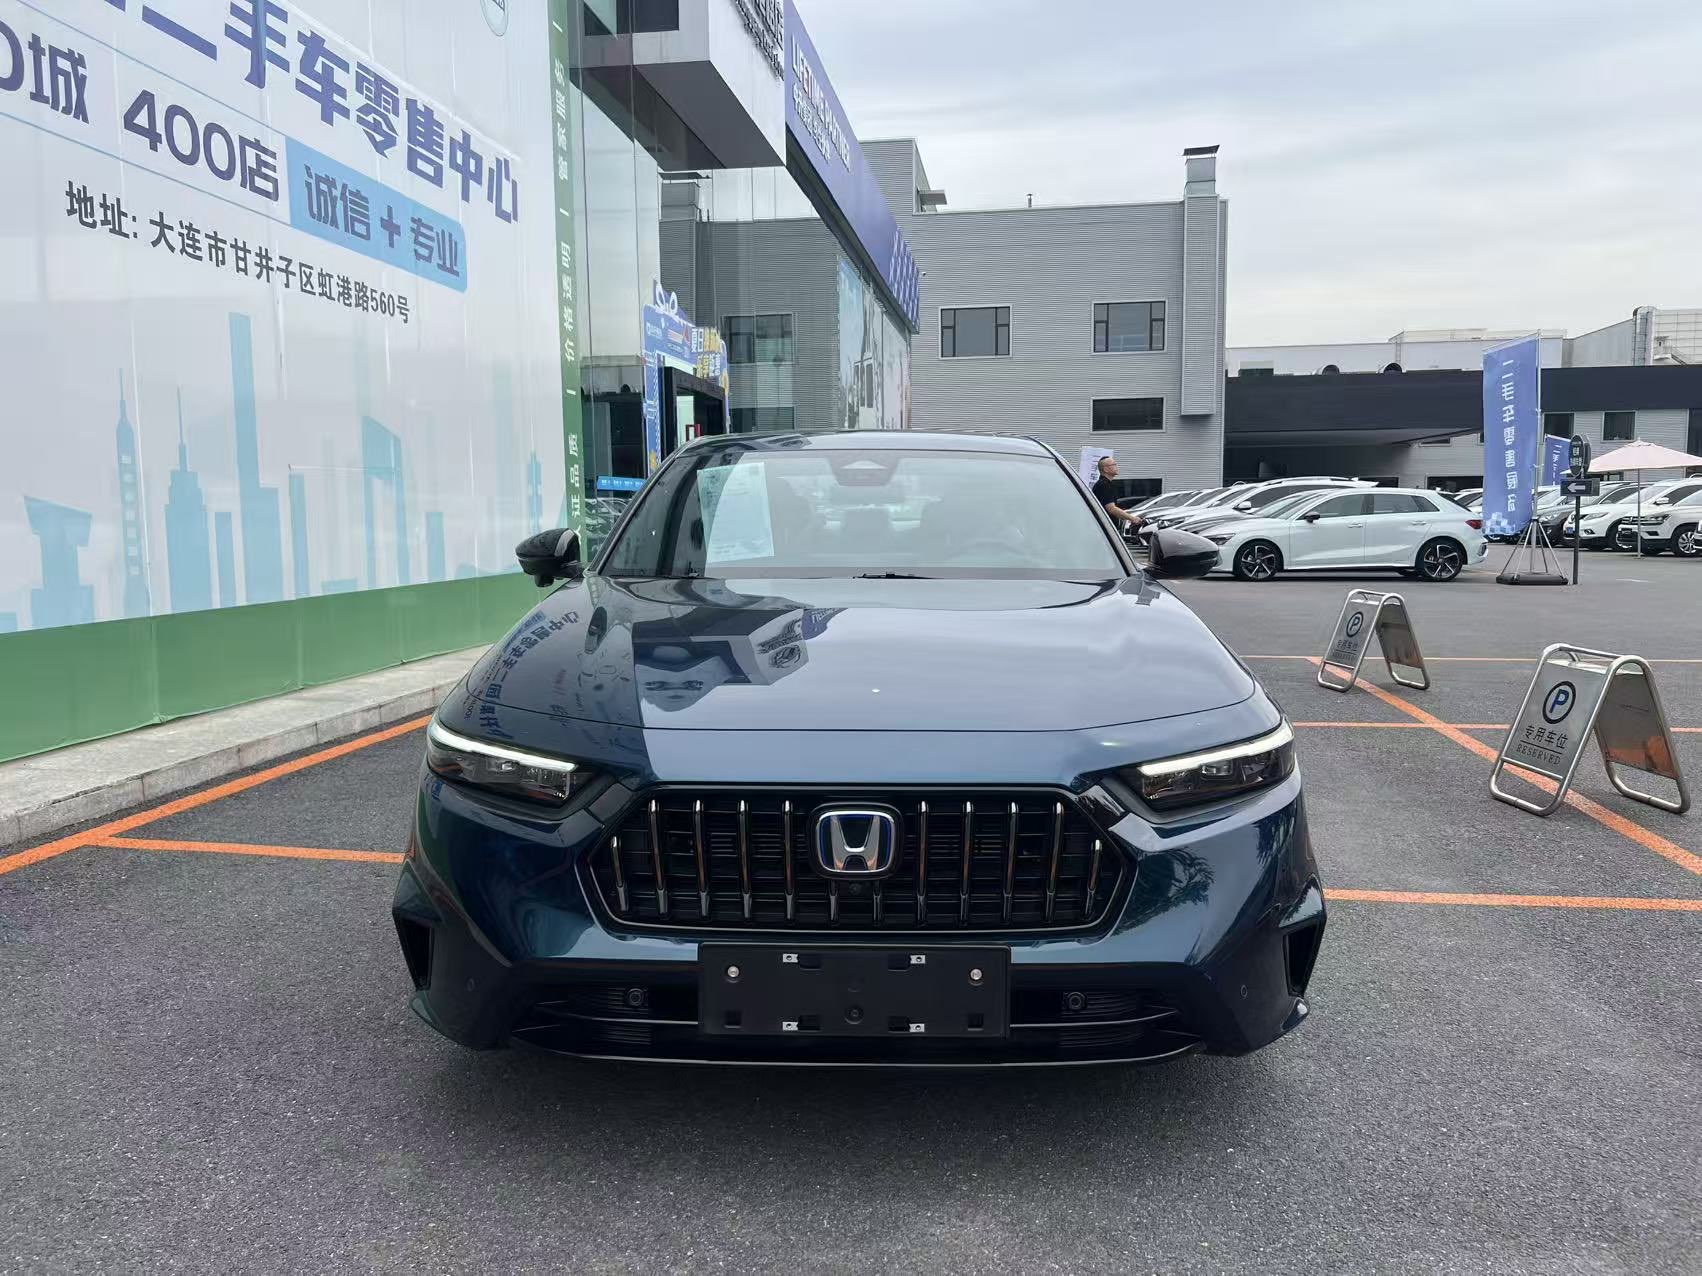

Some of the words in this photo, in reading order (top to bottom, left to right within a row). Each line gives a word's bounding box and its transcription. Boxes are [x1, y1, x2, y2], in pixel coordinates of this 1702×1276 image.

[107, 0, 518, 224] 二手车零售中心
[123, 89, 279, 202] 400店
[304, 164, 371, 241] 诚信
[410, 216, 460, 278] 专业
[1549, 689, 1570, 714] P
[1516, 743, 1561, 765] RESERVED
[1523, 724, 1568, 750] 专用车位
